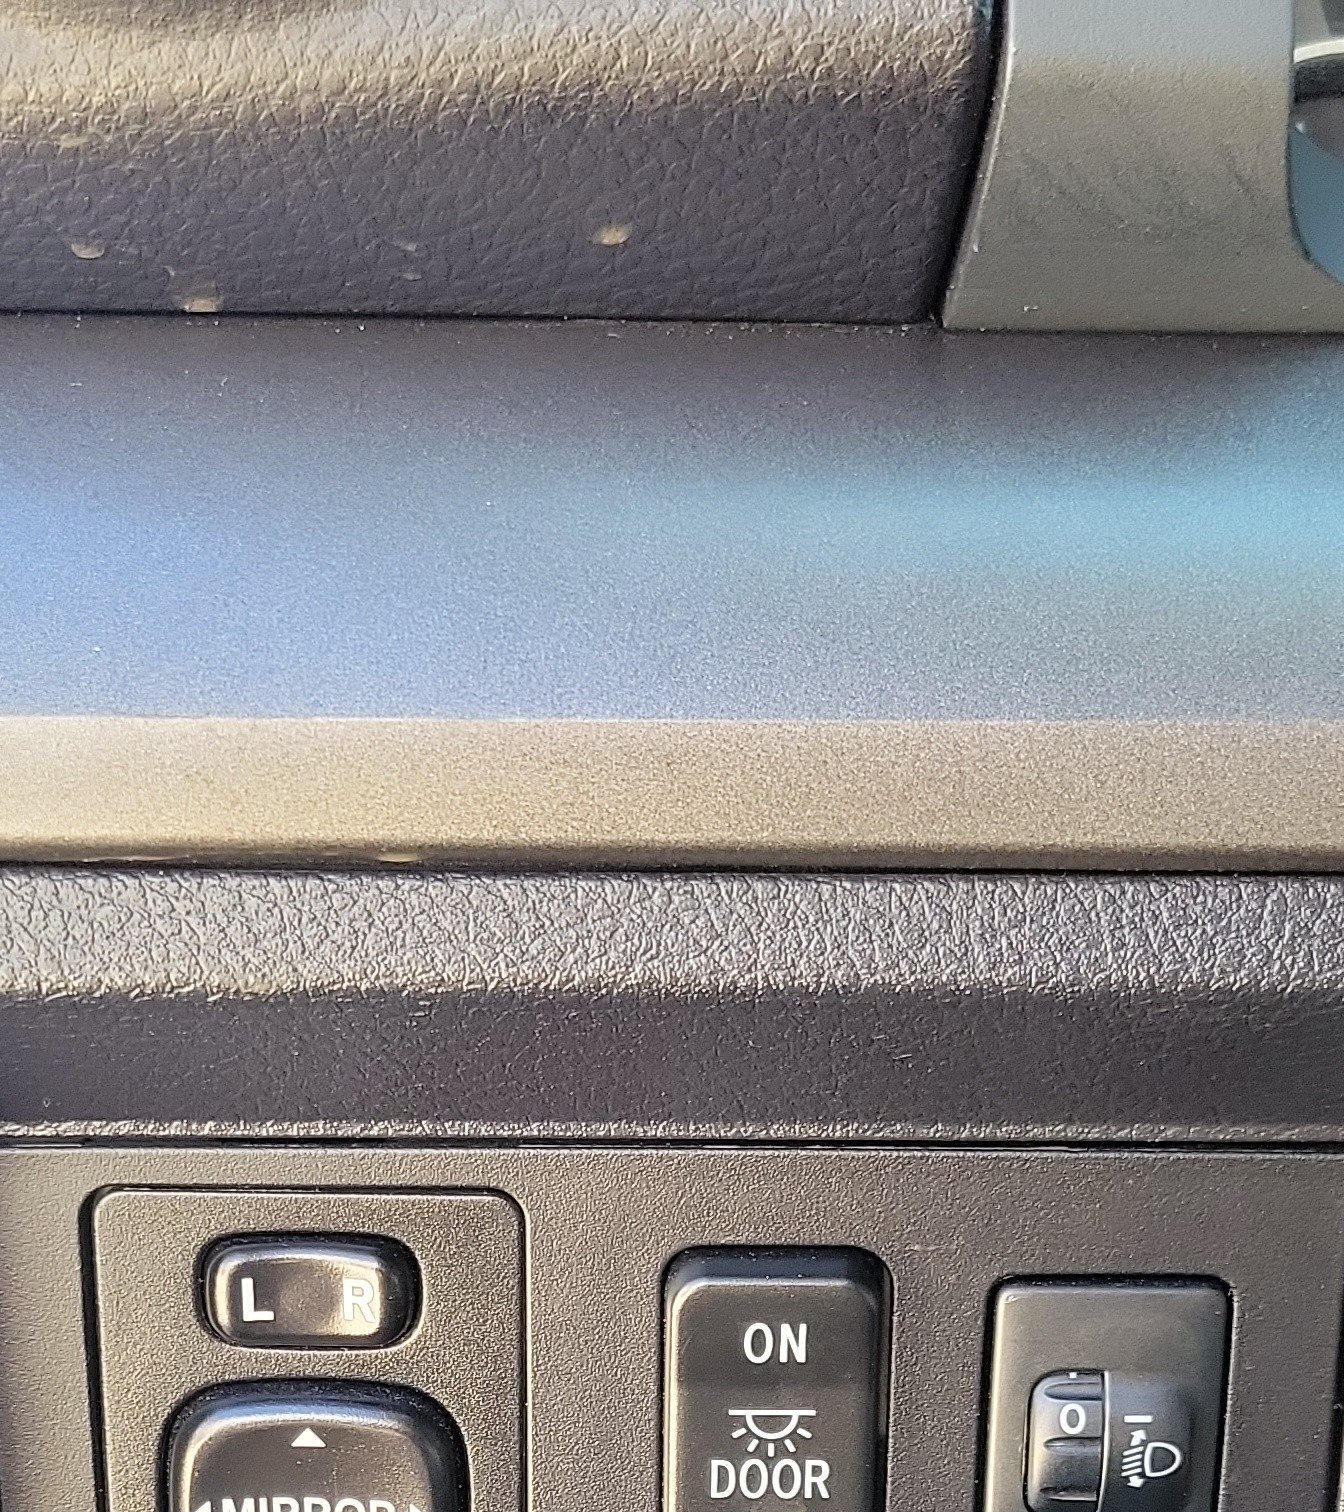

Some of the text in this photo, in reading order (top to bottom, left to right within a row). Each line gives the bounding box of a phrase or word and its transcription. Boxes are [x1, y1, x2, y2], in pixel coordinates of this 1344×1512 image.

[241, 1277, 377, 1324] L R
[743, 1322, 808, 1364] ON
[1059, 1402, 1087, 1435] 0
[710, 1458, 830, 1500] DOOR
